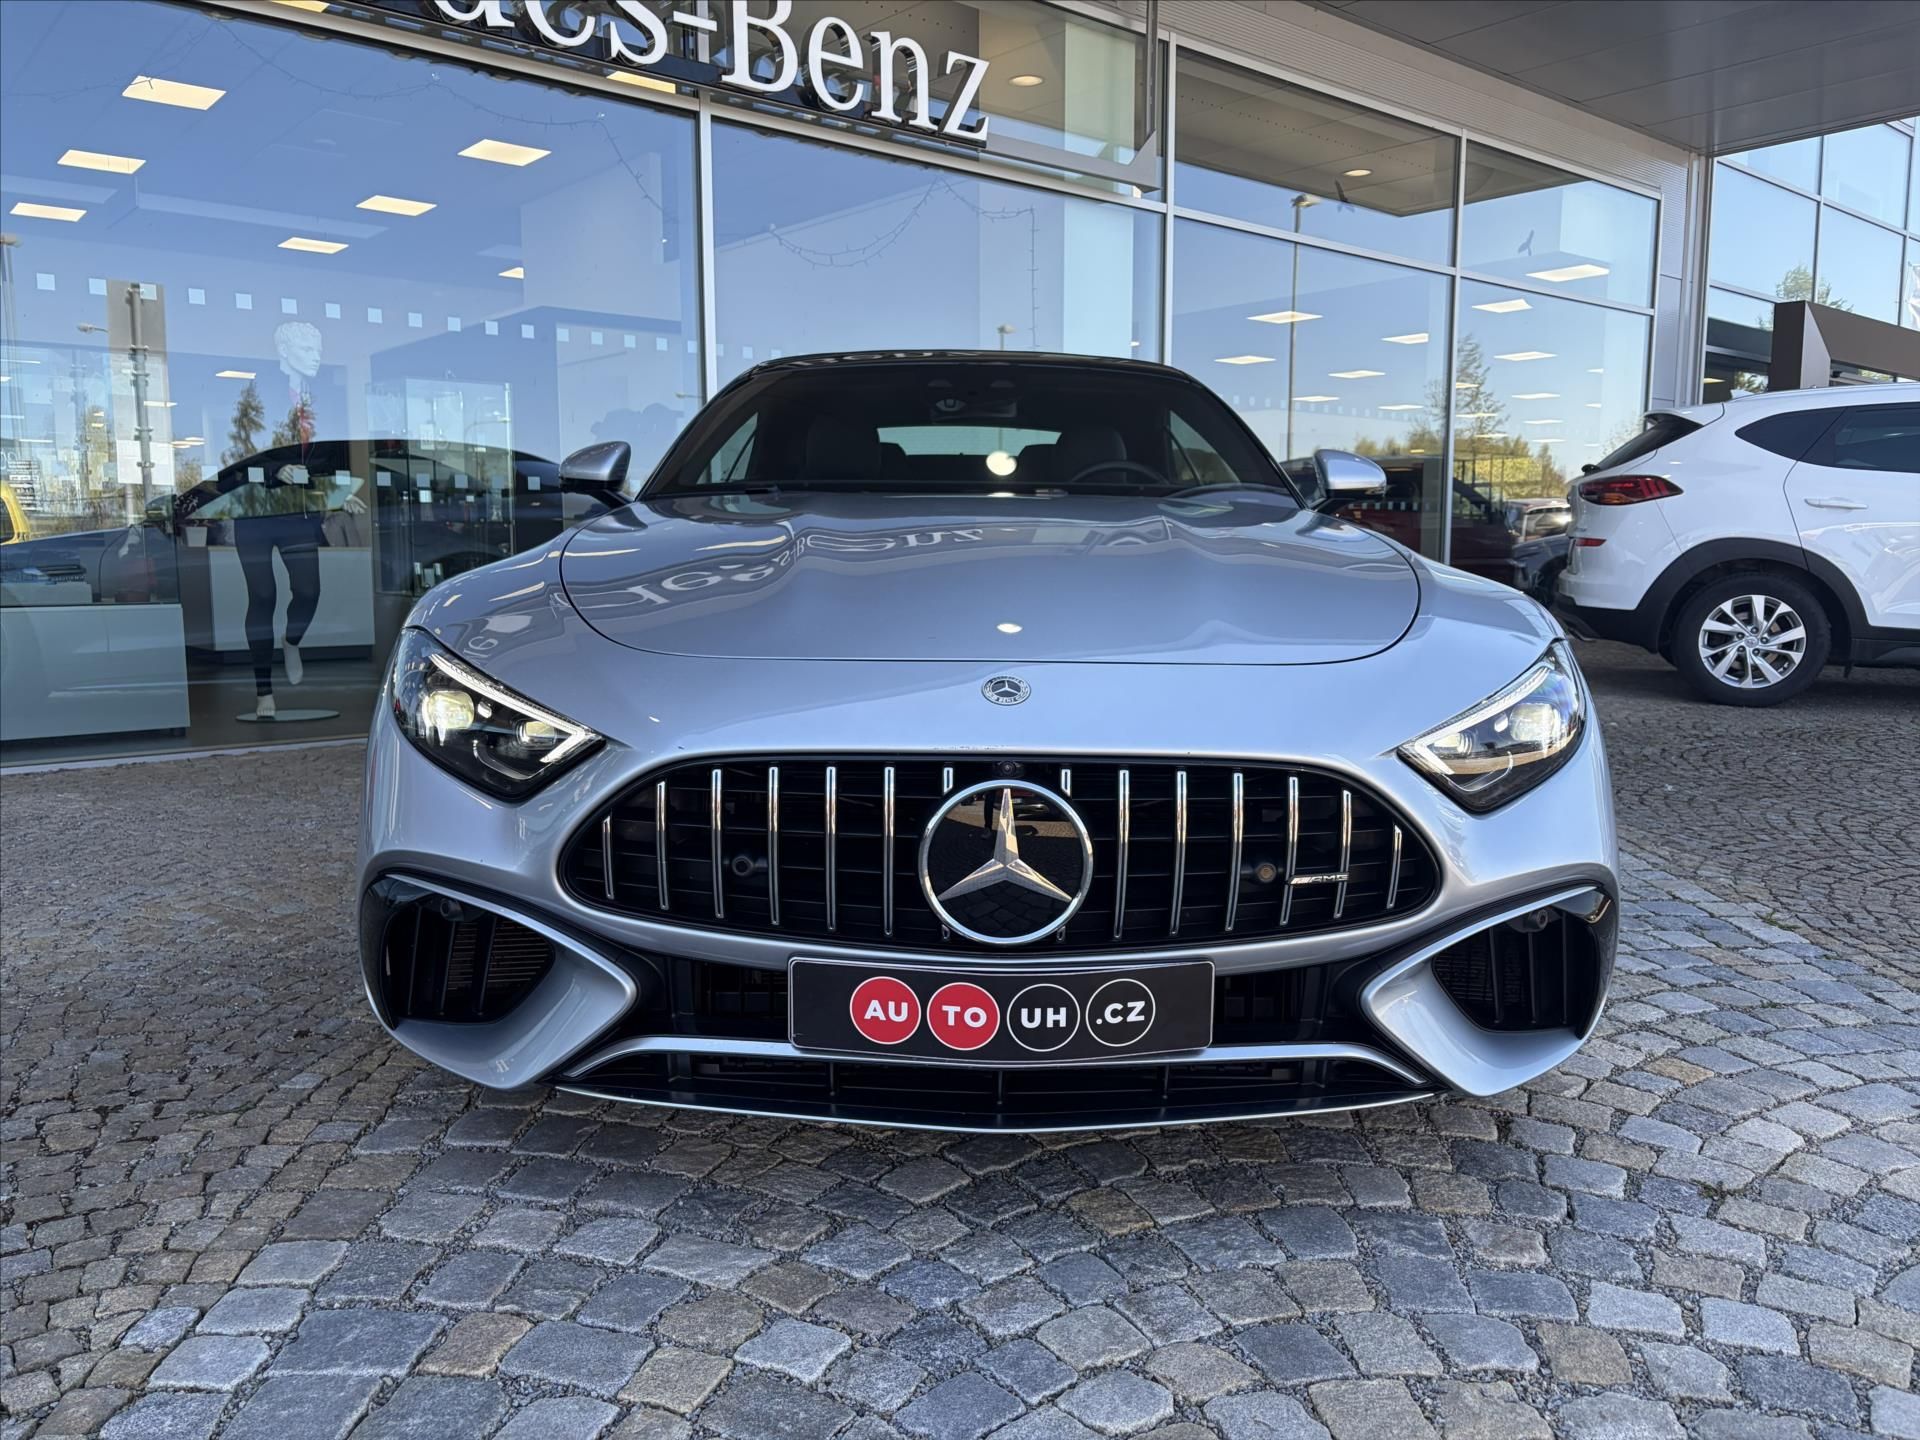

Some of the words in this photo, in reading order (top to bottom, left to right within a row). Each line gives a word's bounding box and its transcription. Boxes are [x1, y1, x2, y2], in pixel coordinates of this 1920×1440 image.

[434, 0, 990, 141] s-Benz
[863, 999, 909, 1023] AU
[941, 1004, 988, 1029] TO
[1020, 1006, 1068, 1029] UH
